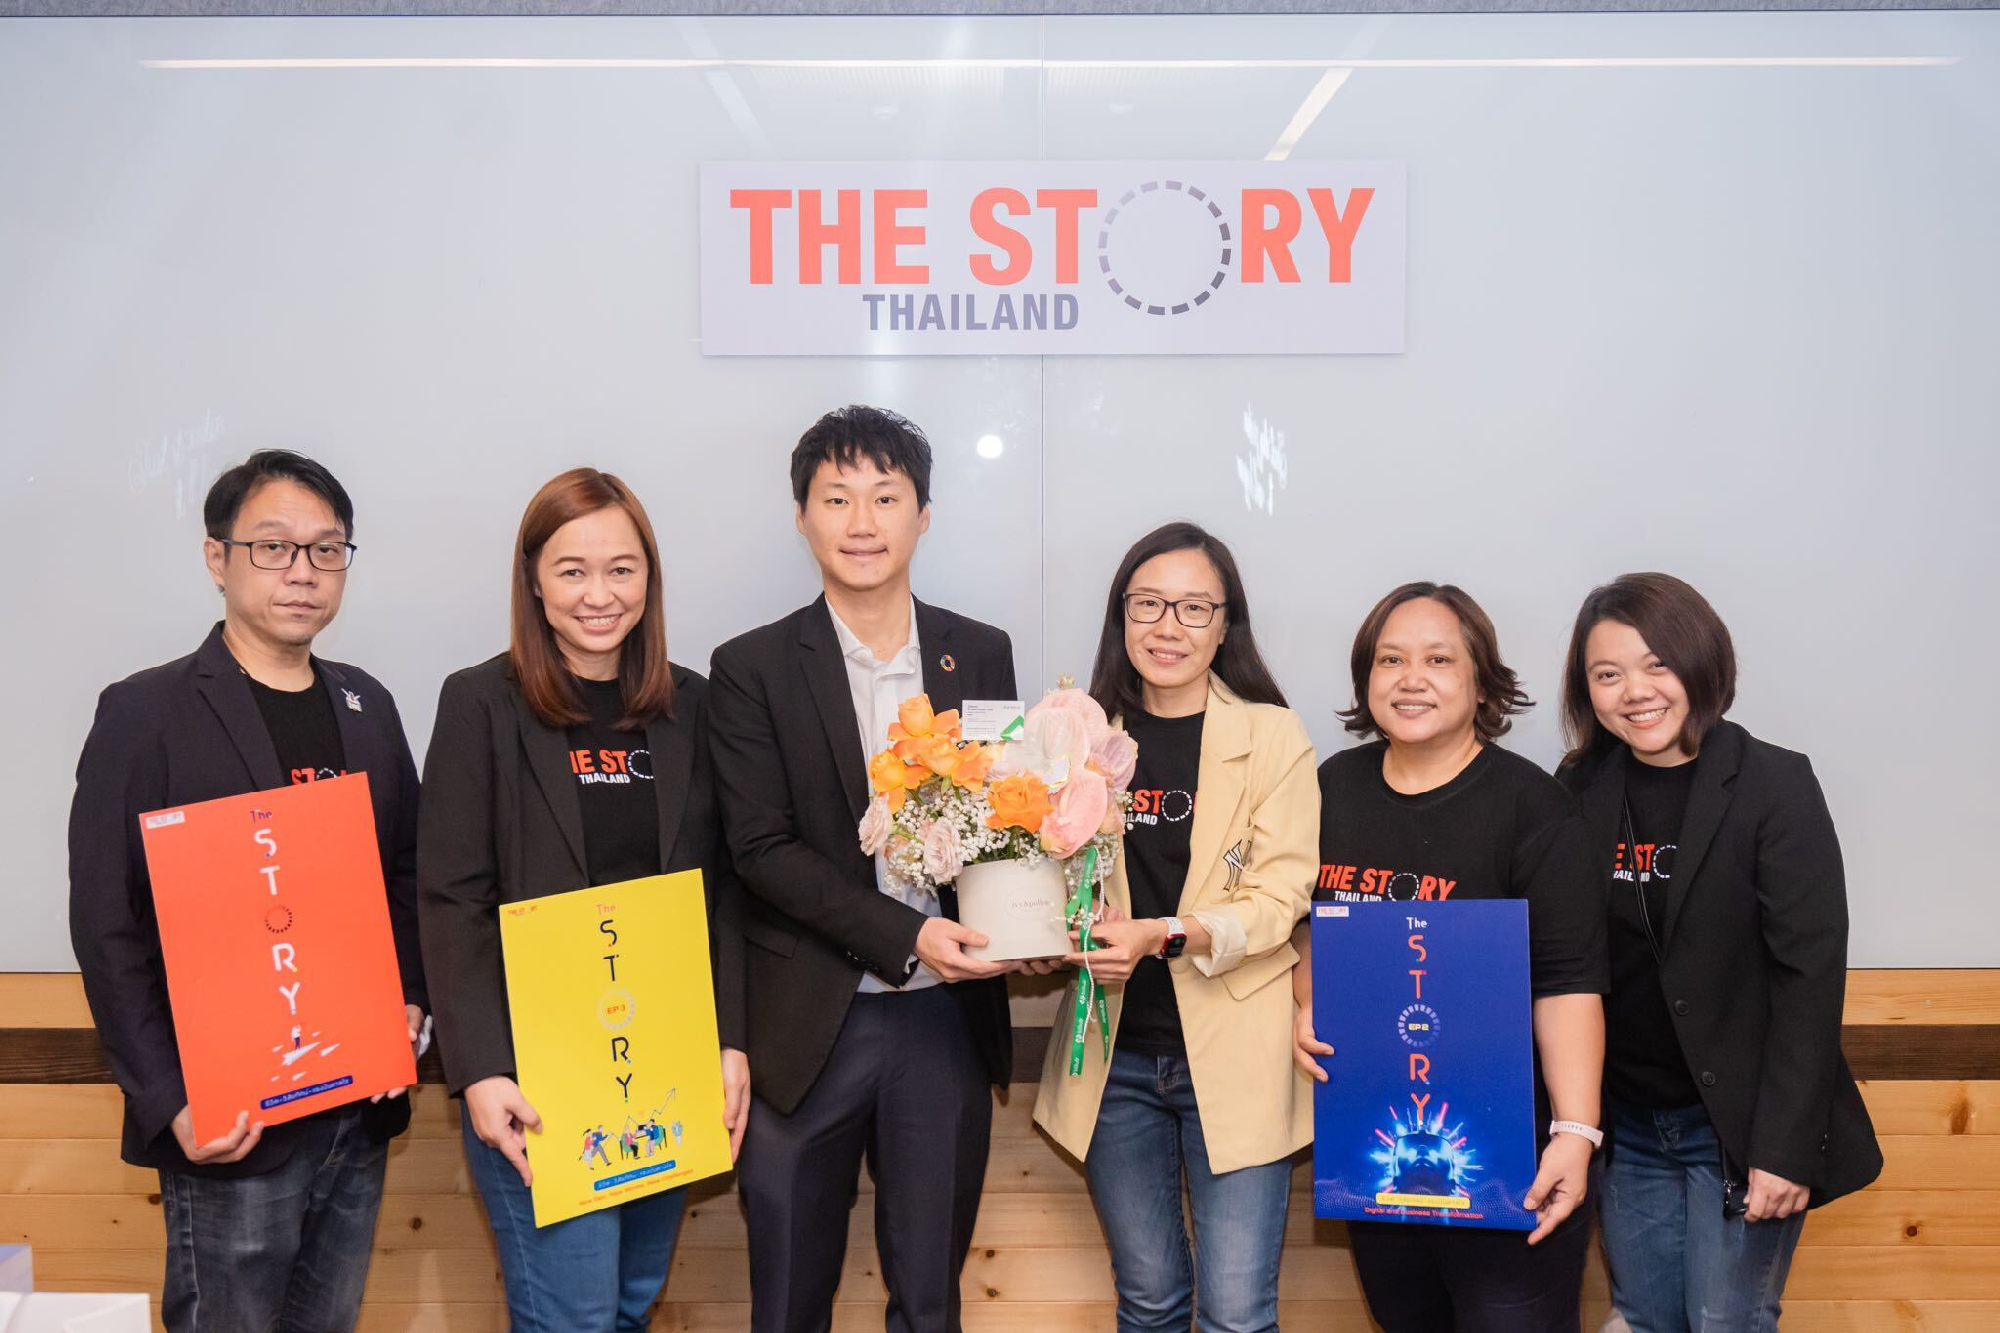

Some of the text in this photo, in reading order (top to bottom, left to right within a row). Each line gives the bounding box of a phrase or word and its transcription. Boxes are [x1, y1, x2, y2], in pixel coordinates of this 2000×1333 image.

[730, 180, 1376, 316] THE STORY
[862, 293, 1079, 331] THAILAND
[579, 773, 631, 784] THAILAND
[250, 809, 272, 823] The
[1319, 864, 1457, 902] THE STORY
[595, 903, 616, 916] The
[1406, 916, 1428, 930] The
